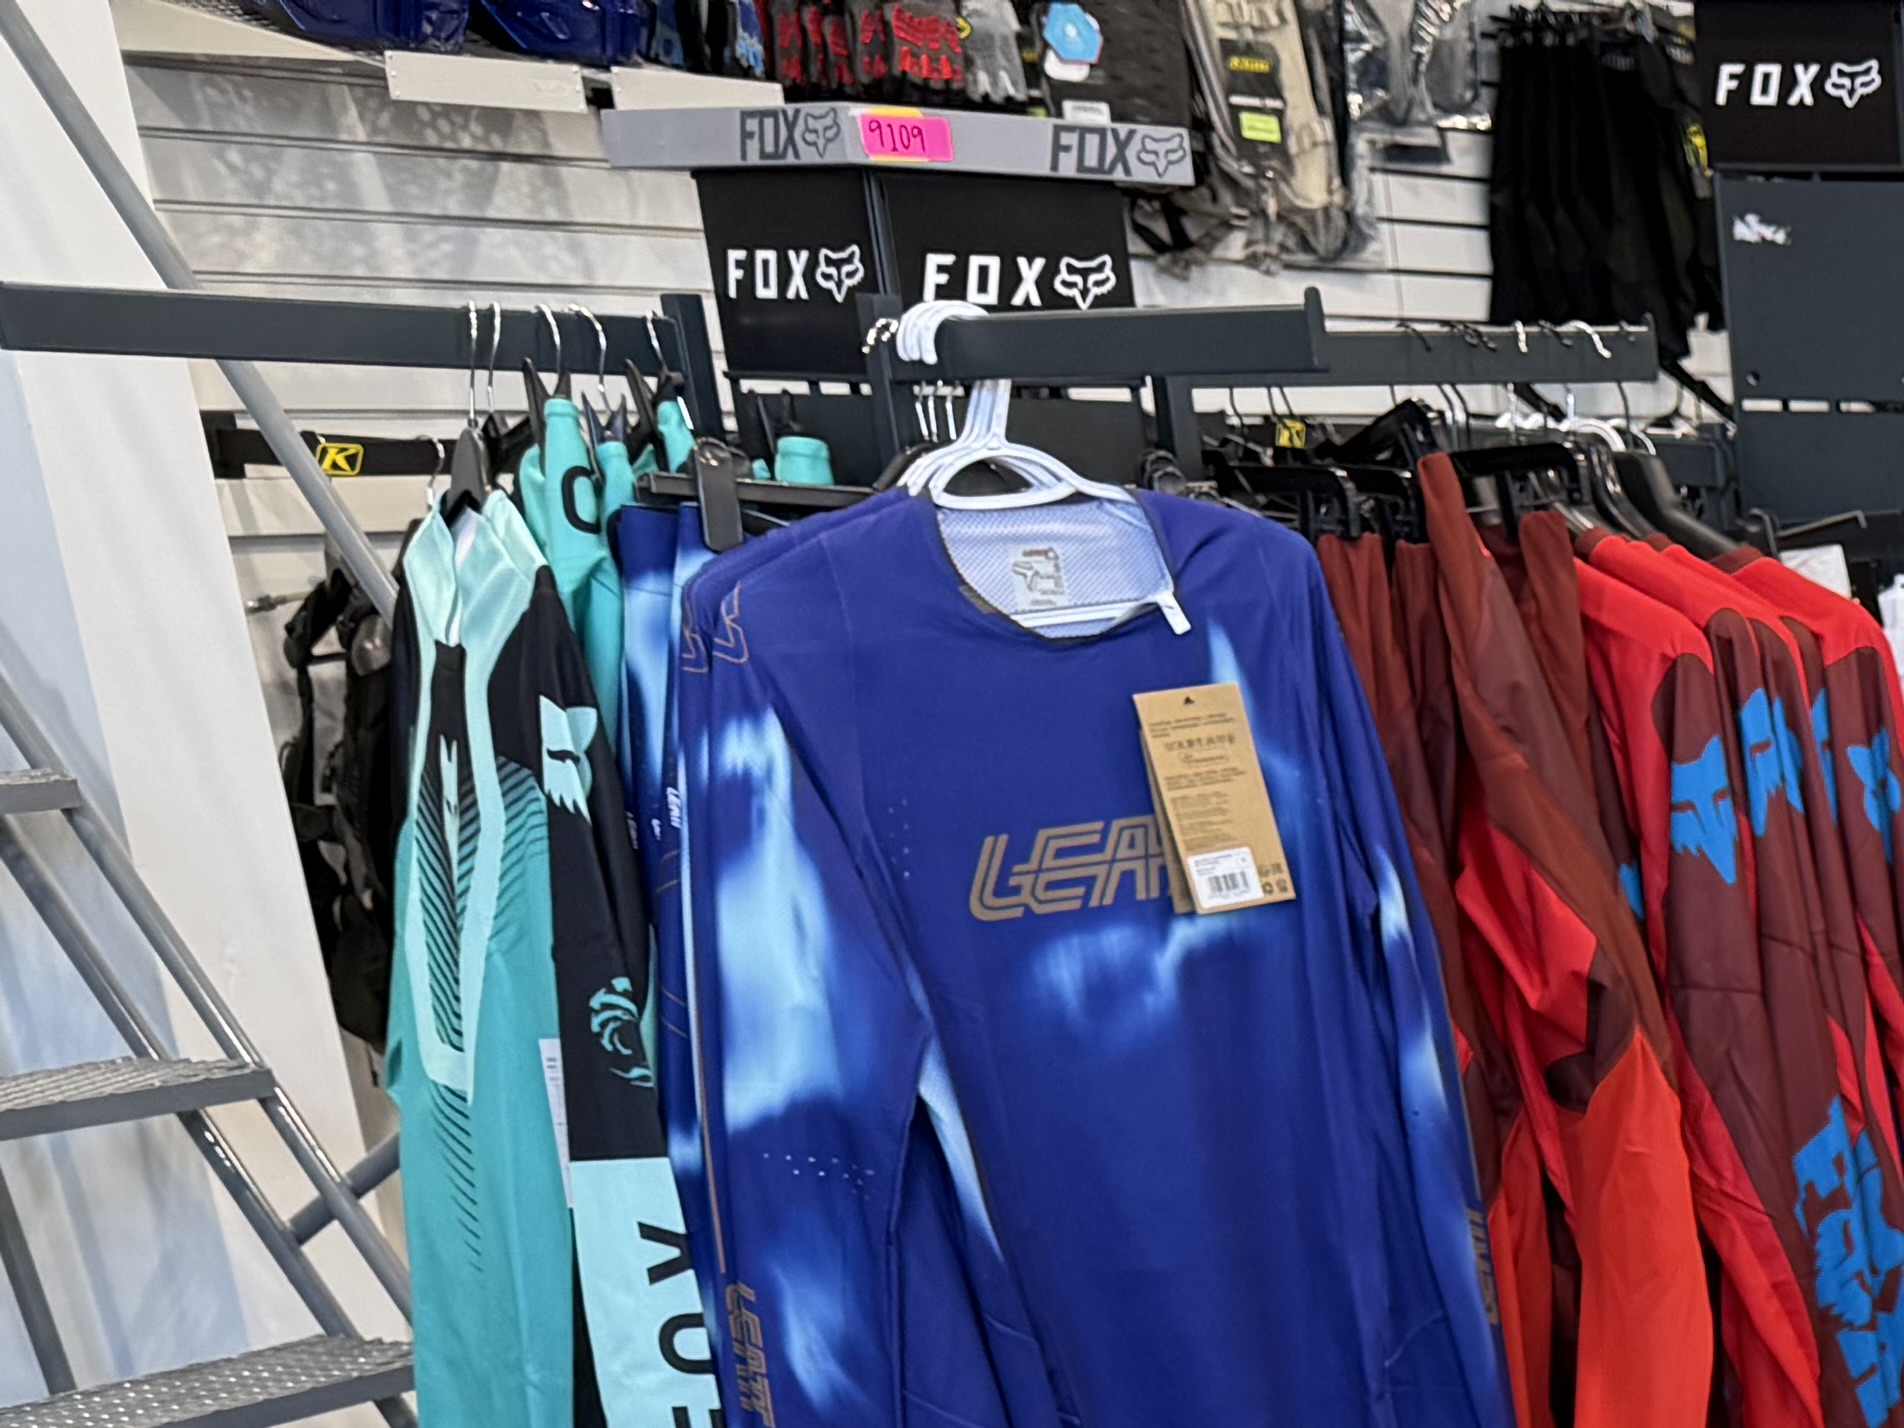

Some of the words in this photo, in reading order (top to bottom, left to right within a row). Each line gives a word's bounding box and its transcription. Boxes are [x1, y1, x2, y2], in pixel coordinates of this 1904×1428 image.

[1715, 62, 1820, 107] FOX
[740, 109, 801, 161] FOX
[868, 119, 927, 153] 9109
[1050, 124, 1137, 177] FOX
[727, 249, 810, 300] FOX
[922, 253, 1046, 306] FOX
